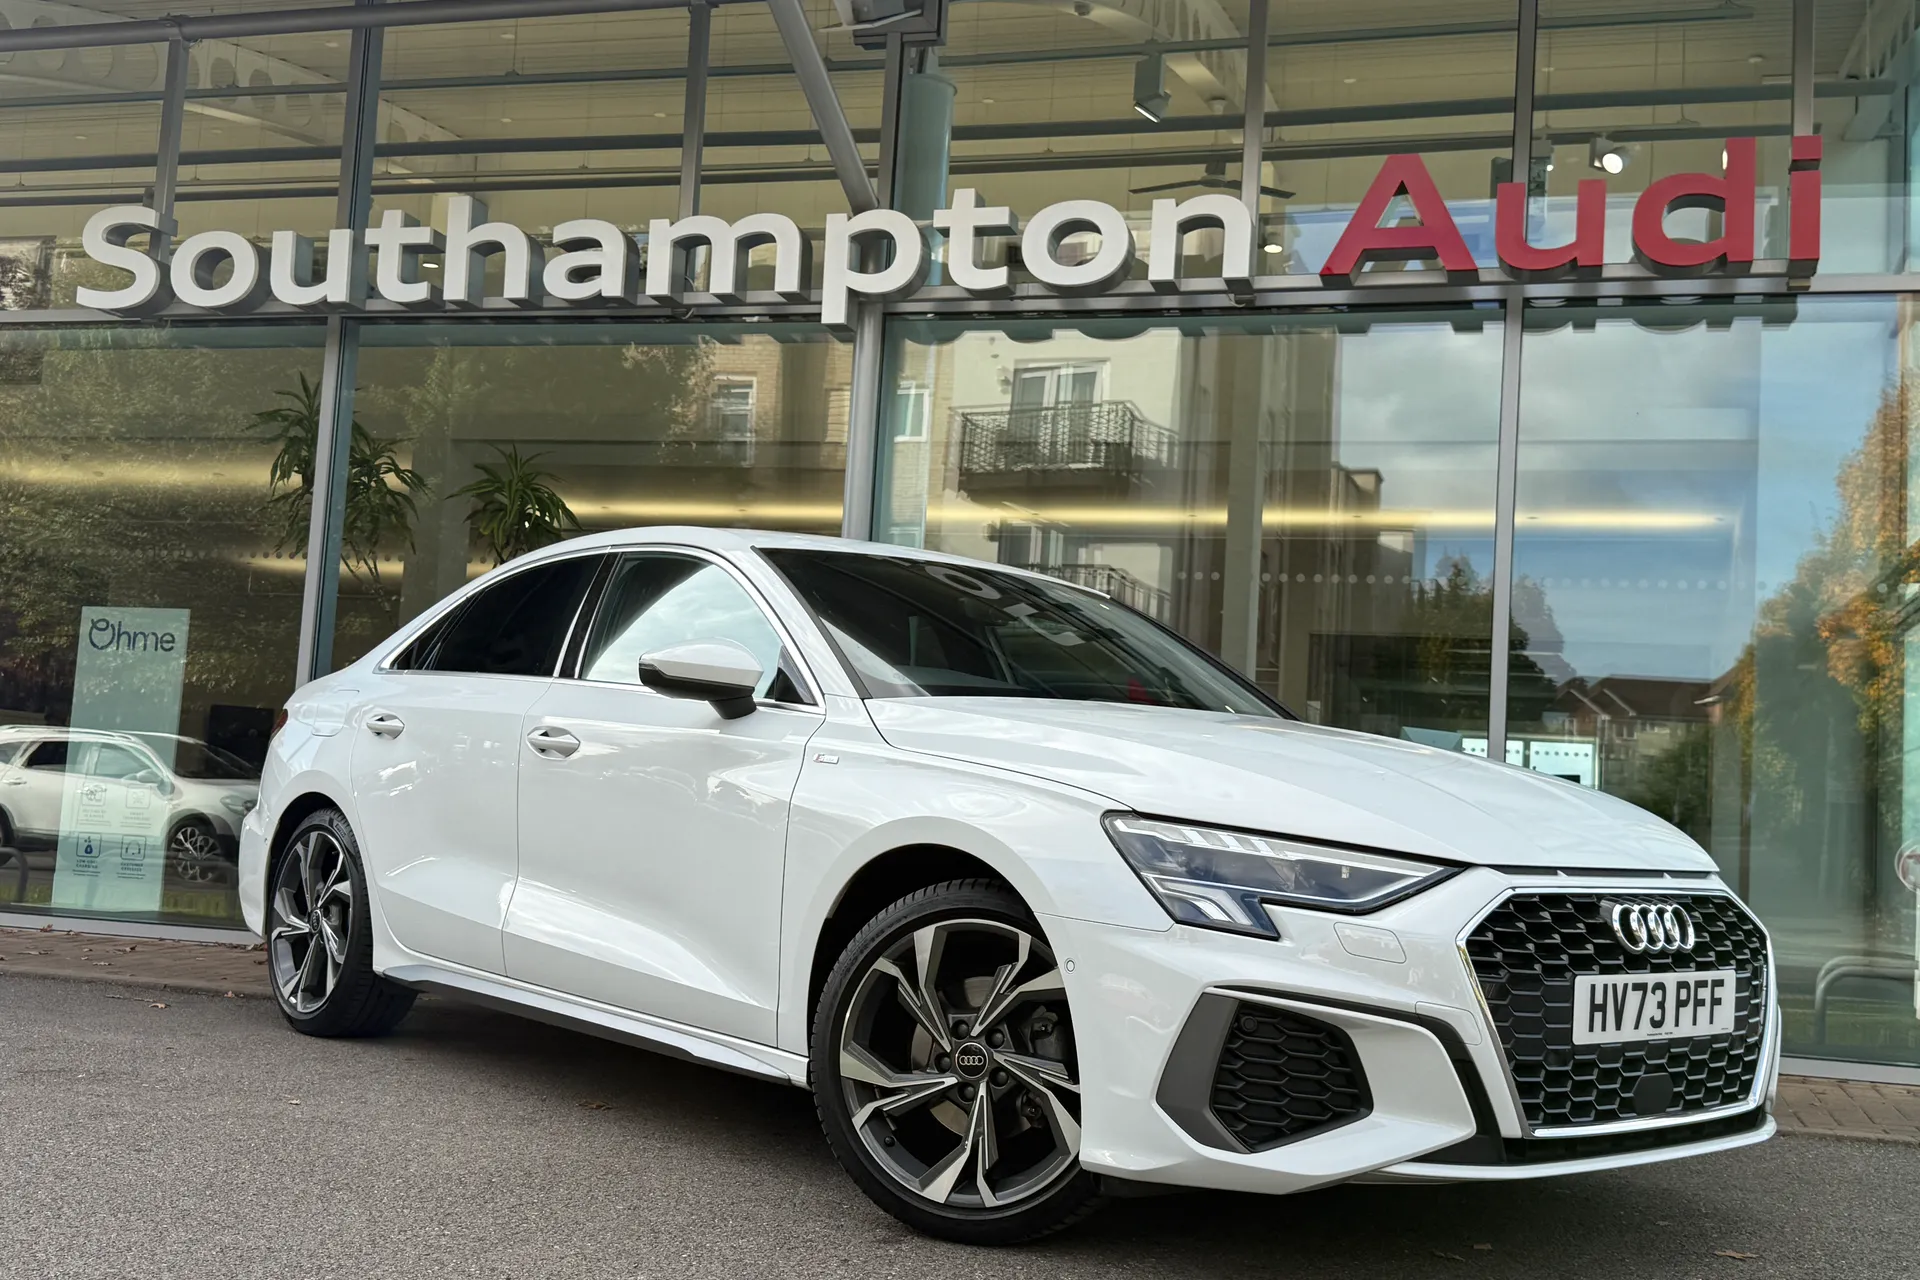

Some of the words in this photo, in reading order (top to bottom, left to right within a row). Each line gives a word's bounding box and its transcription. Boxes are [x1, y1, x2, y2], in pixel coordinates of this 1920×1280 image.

[76, 188, 1254, 324] Southampton
[1321, 135, 1822, 284] Audi
[89, 618, 176, 651] Ohme
[1588, 982, 1667, 1032] HV73
[1674, 979, 1725, 1027] PFF
